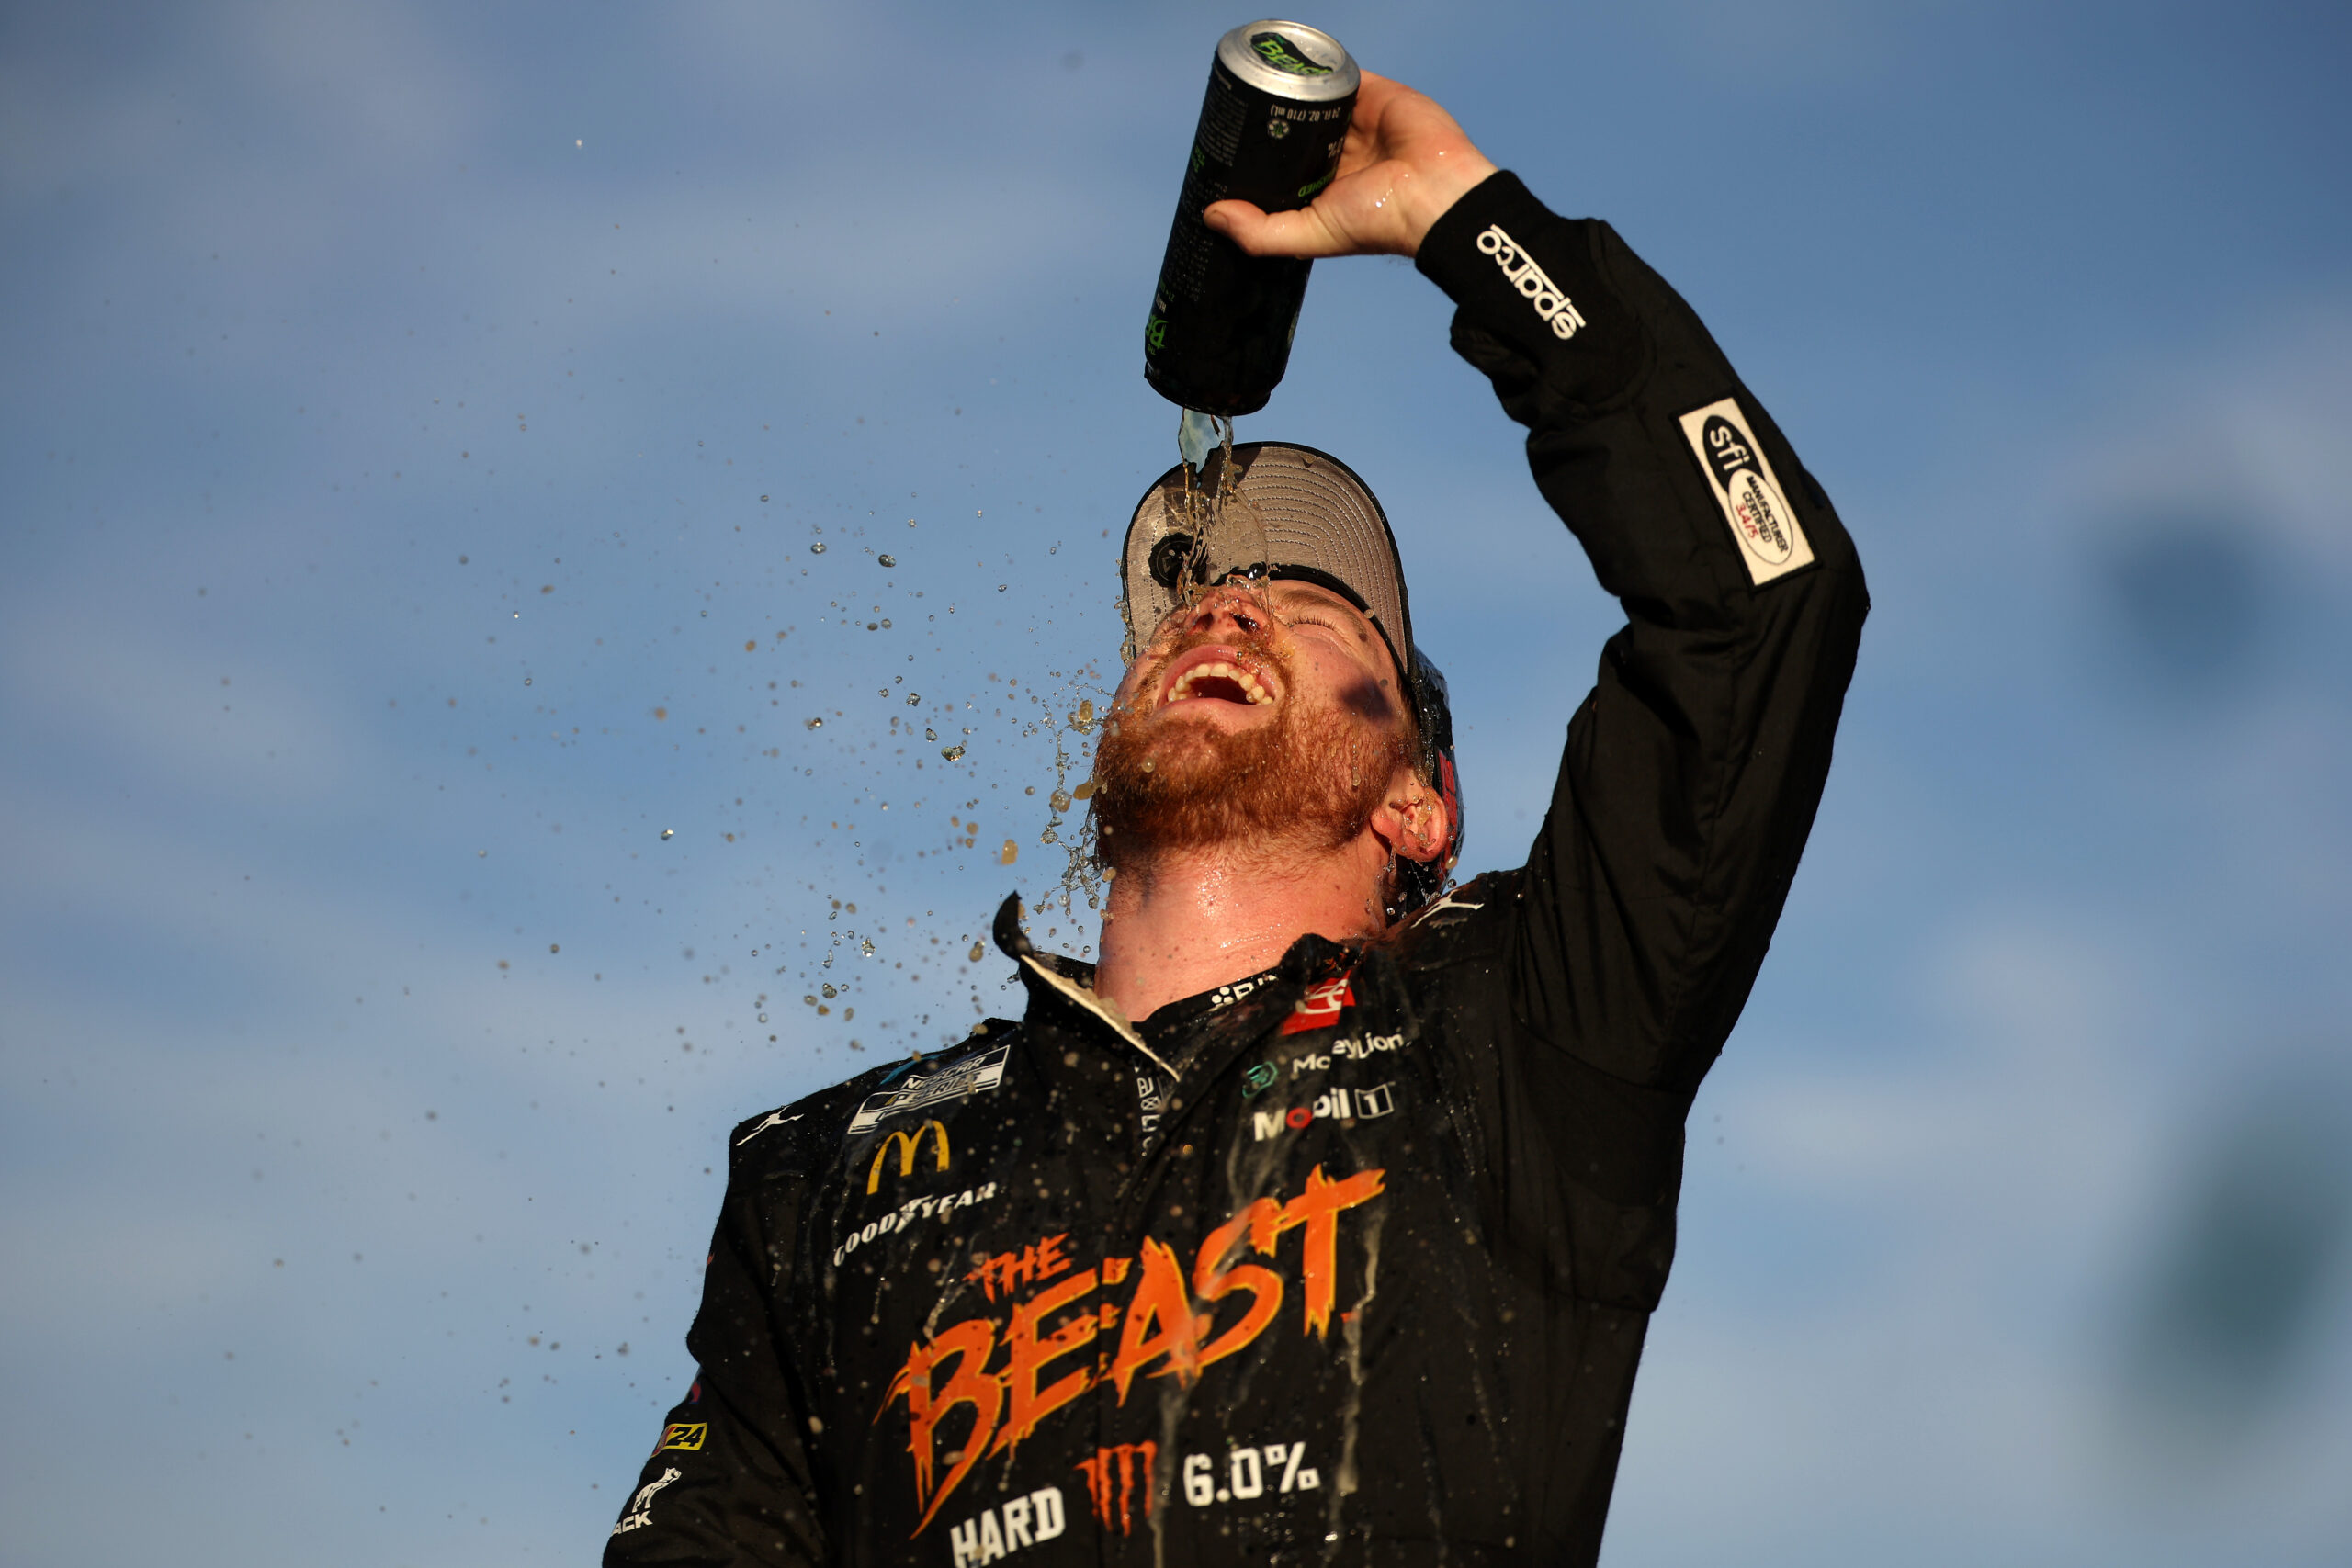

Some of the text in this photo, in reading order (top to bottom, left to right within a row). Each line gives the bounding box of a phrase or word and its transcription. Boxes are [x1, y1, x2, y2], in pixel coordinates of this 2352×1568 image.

[1476, 224, 1585, 340] sparco
[1710, 425, 1750, 470] sfi
[1742, 491, 1772, 543] CERTIFIED
[1746, 475, 1789, 554] MANUFACTURER
[964, 1233, 1070, 1303] THE
[873, 1164, 1385, 1540] BEAST
[666, 1427, 705, 1447] 24
[1183, 1441, 1320, 1507] 6.0%
[612, 1510, 653, 1536] ACK
[950, 1486, 1066, 1568] HARD
